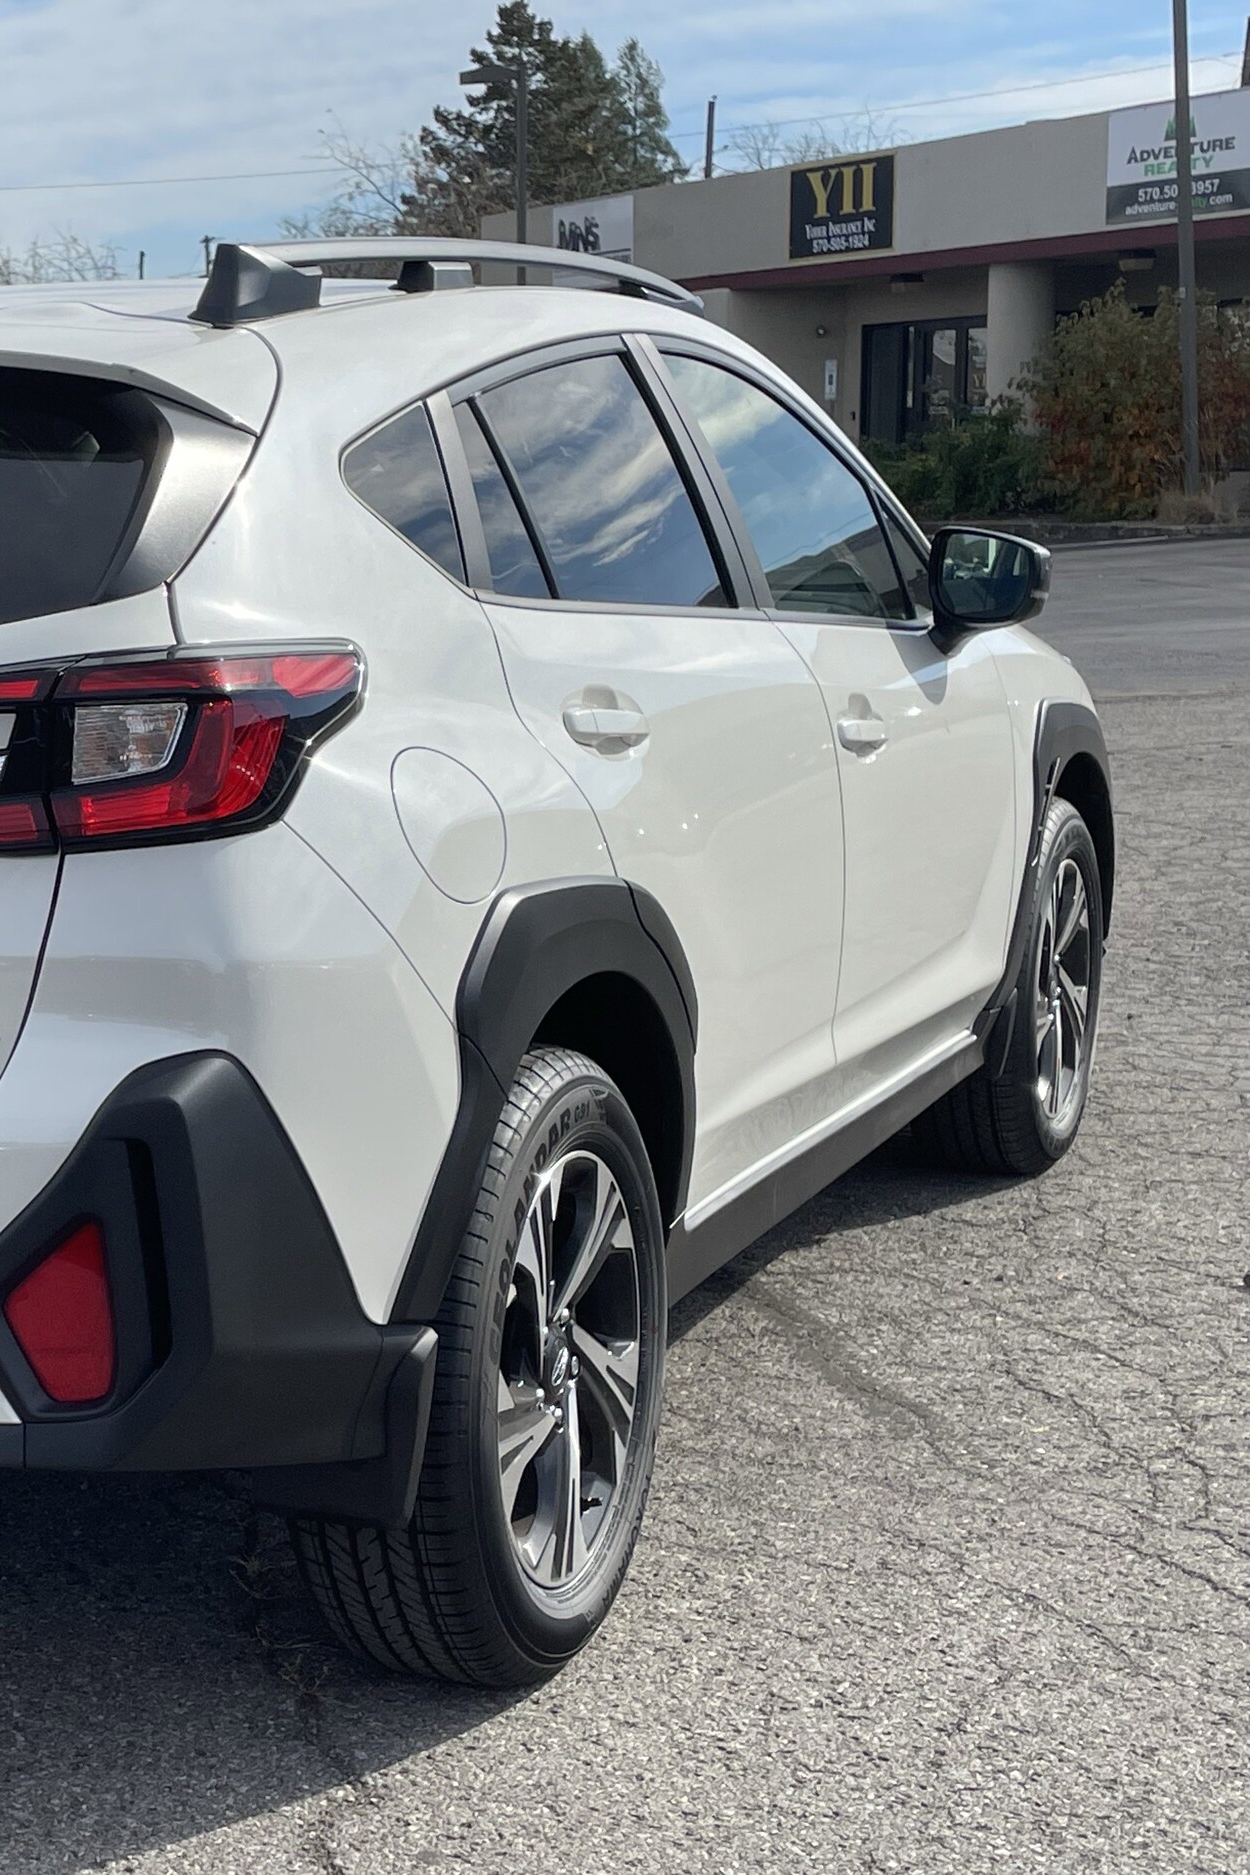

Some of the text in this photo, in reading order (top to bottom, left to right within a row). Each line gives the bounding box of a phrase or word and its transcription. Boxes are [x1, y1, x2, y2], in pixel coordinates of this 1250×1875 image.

[1126, 136, 1236, 165] ADVETURE
[1144, 155, 1214, 177] REATY
[806, 162, 877, 218] YII
